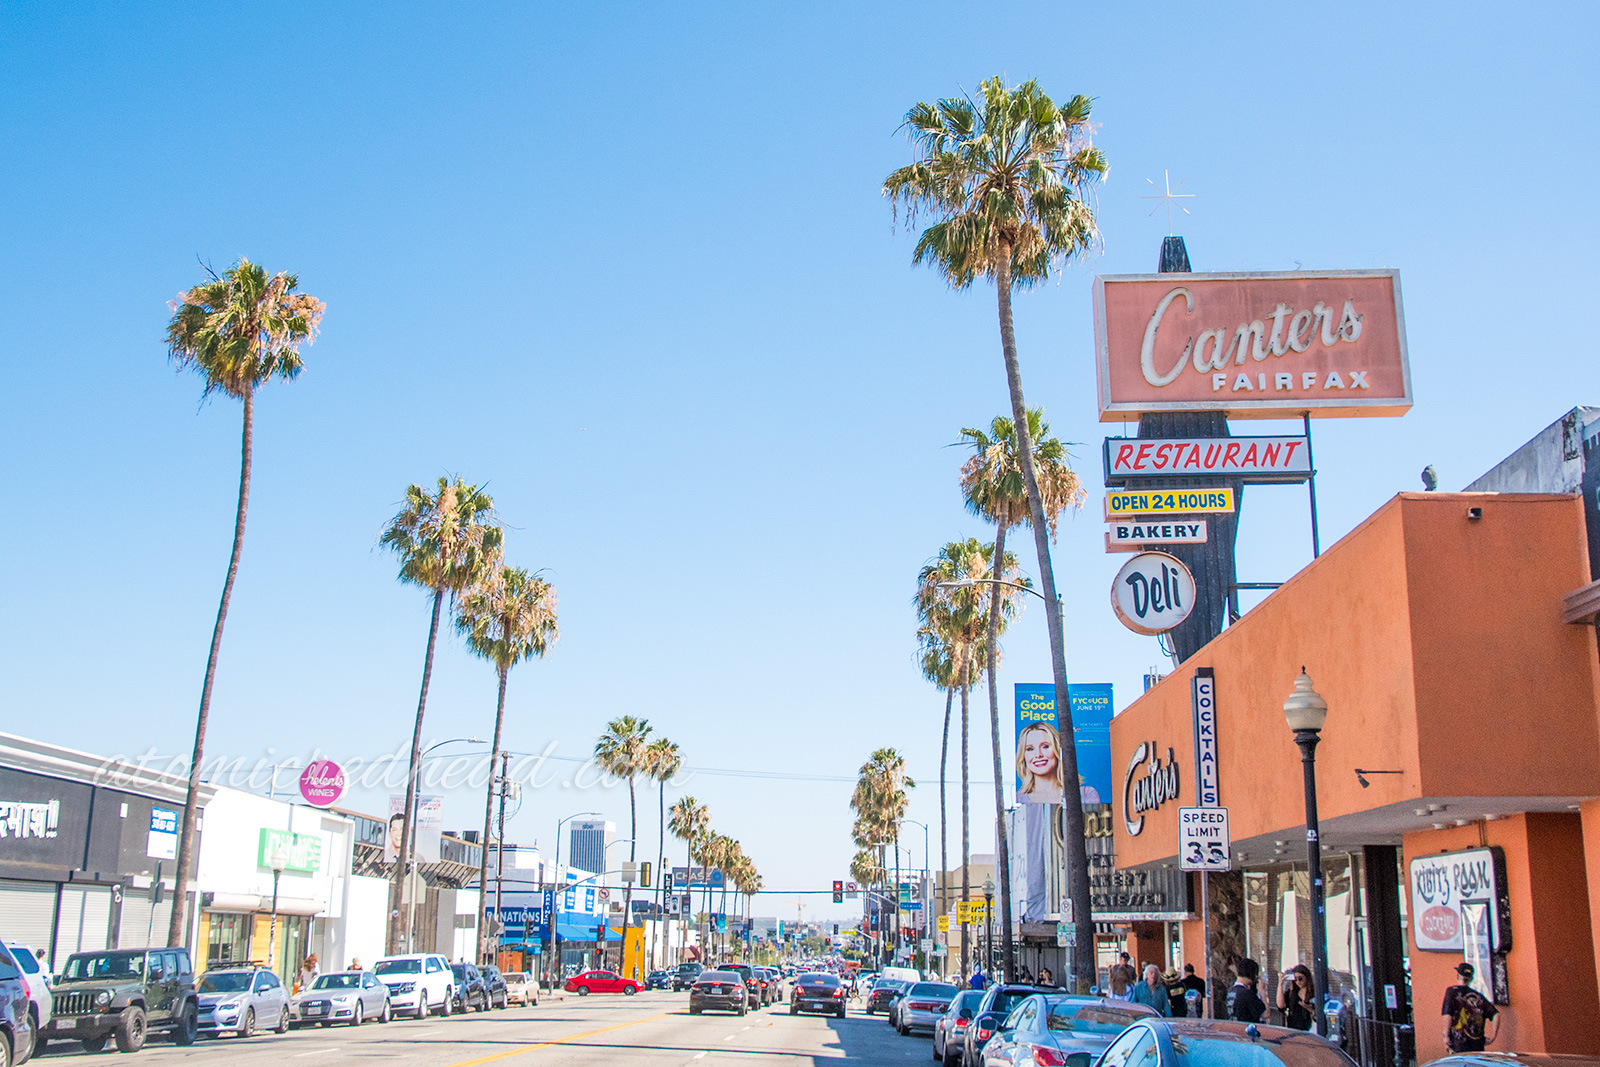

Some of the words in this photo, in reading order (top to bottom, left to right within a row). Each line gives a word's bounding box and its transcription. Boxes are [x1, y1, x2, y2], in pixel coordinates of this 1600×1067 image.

[1141, 287, 1365, 387] Canters
[1212, 371, 1370, 392] FAIRFAX
[1114, 441, 1303, 471] RESTAURANT
[1111, 495, 1149, 511] OPEN
[1152, 494, 1176, 509] 24
[1179, 493, 1226, 508] HOURS
[1117, 525, 1200, 539] BAKERY
[1125, 562, 1181, 619] Deli
[1020, 699, 1055, 710] Good
[1020, 710, 1056, 721] Place
[1199, 684, 1216, 803] COCKTAILS
[308, 788, 335, 797] WINES
[1122, 740, 1181, 837] Canter's
[1183, 812, 1225, 824] SPEED
[1187, 827, 1220, 837] LIMIT
[1186, 841, 1226, 864] 35
[1091, 873, 1148, 888] AKERY
[1453, 860, 1490, 898] ROOM
